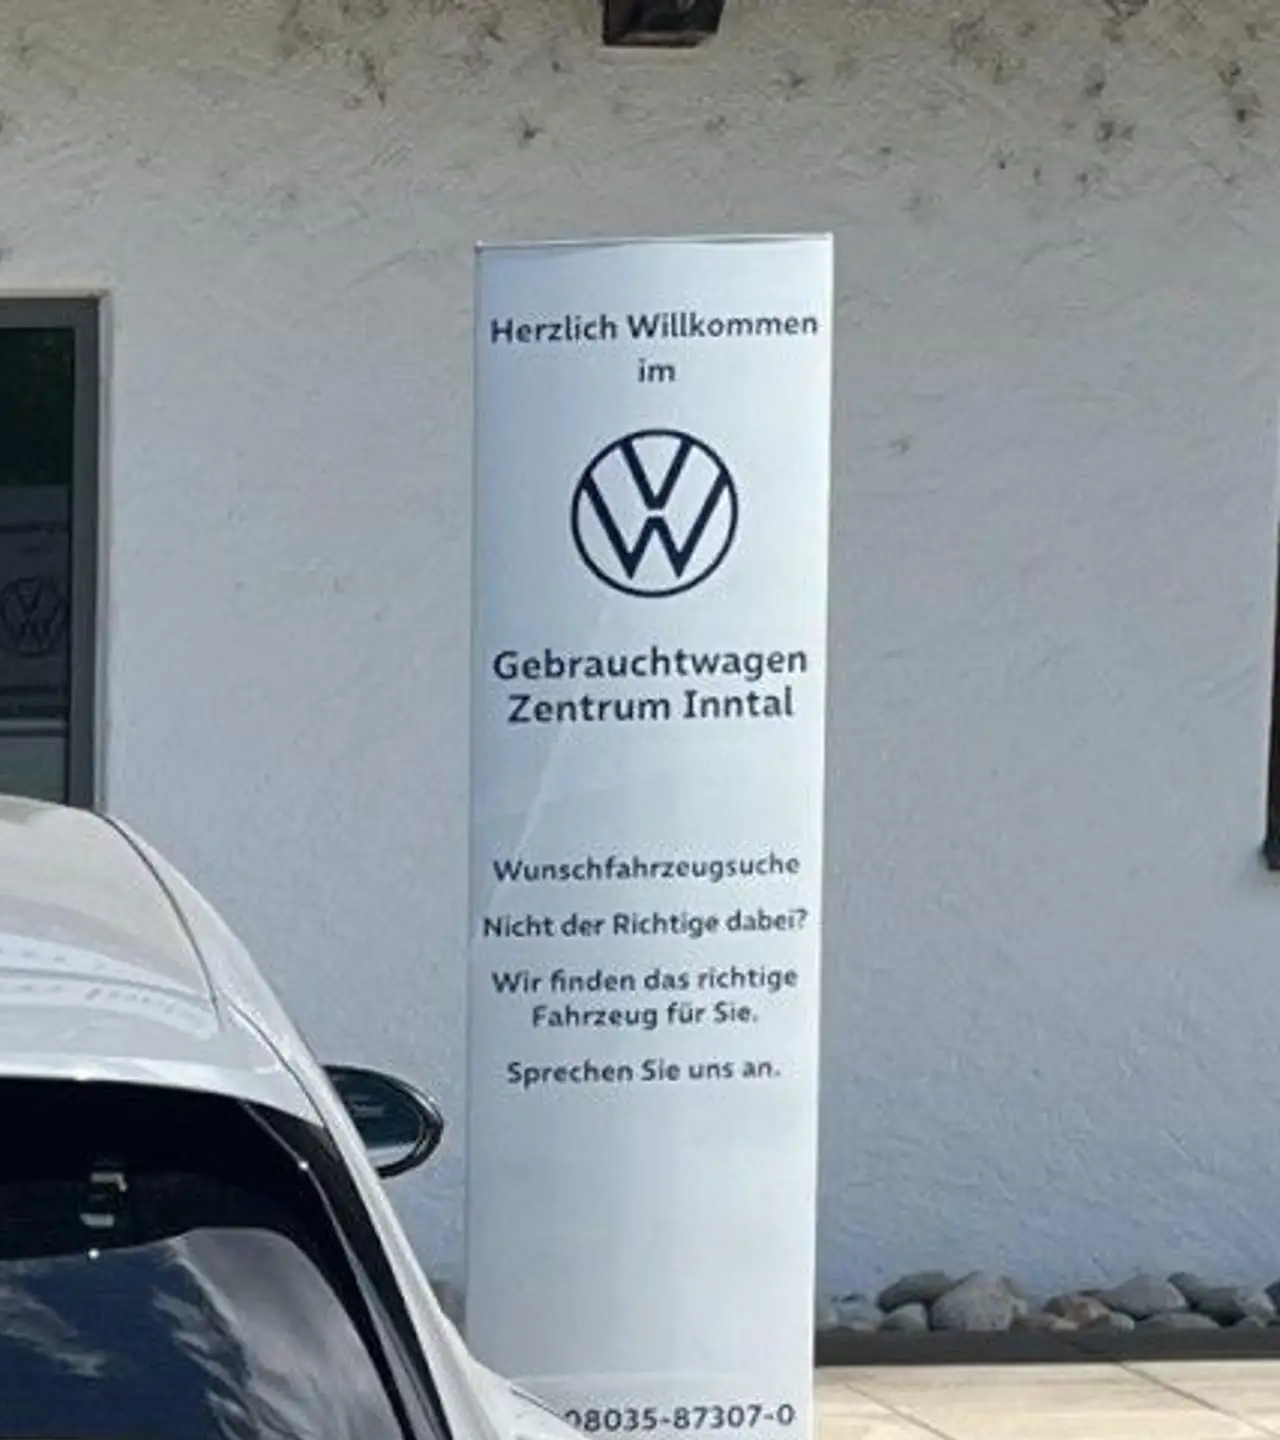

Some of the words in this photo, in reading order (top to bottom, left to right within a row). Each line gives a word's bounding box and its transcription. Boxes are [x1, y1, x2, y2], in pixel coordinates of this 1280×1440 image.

[491, 313, 618, 343] Herzlich
[626, 311, 818, 339] Willkommen
[638, 358, 676, 383] im
[571, 428, 738, 598] VW
[493, 646, 807, 686] Gebrauchtwagen
[508, 694, 671, 723] Zentrum
[683, 685, 793, 719] Inntal
[493, 852, 800, 882] Wunschfahrzeugsuche
[483, 914, 554, 937] Nicht
[560, 913, 605, 937] der
[613, 911, 720, 939] Richtige
[725, 908, 808, 932] dabei?
[491, 972, 542, 994] Wir
[550, 968, 636, 993] finden
[643, 968, 690, 991] das
[697, 965, 799, 993] richtige
[532, 1004, 658, 1031] Fahrzeug
[666, 1001, 706, 1024] für
[713, 1001, 757, 1024] Sie.
[507, 1058, 634, 1090] Sprechen
[641, 1058, 681, 1082] Sie
[688, 1061, 734, 1080] uns
[742, 1061, 781, 1078] an.
